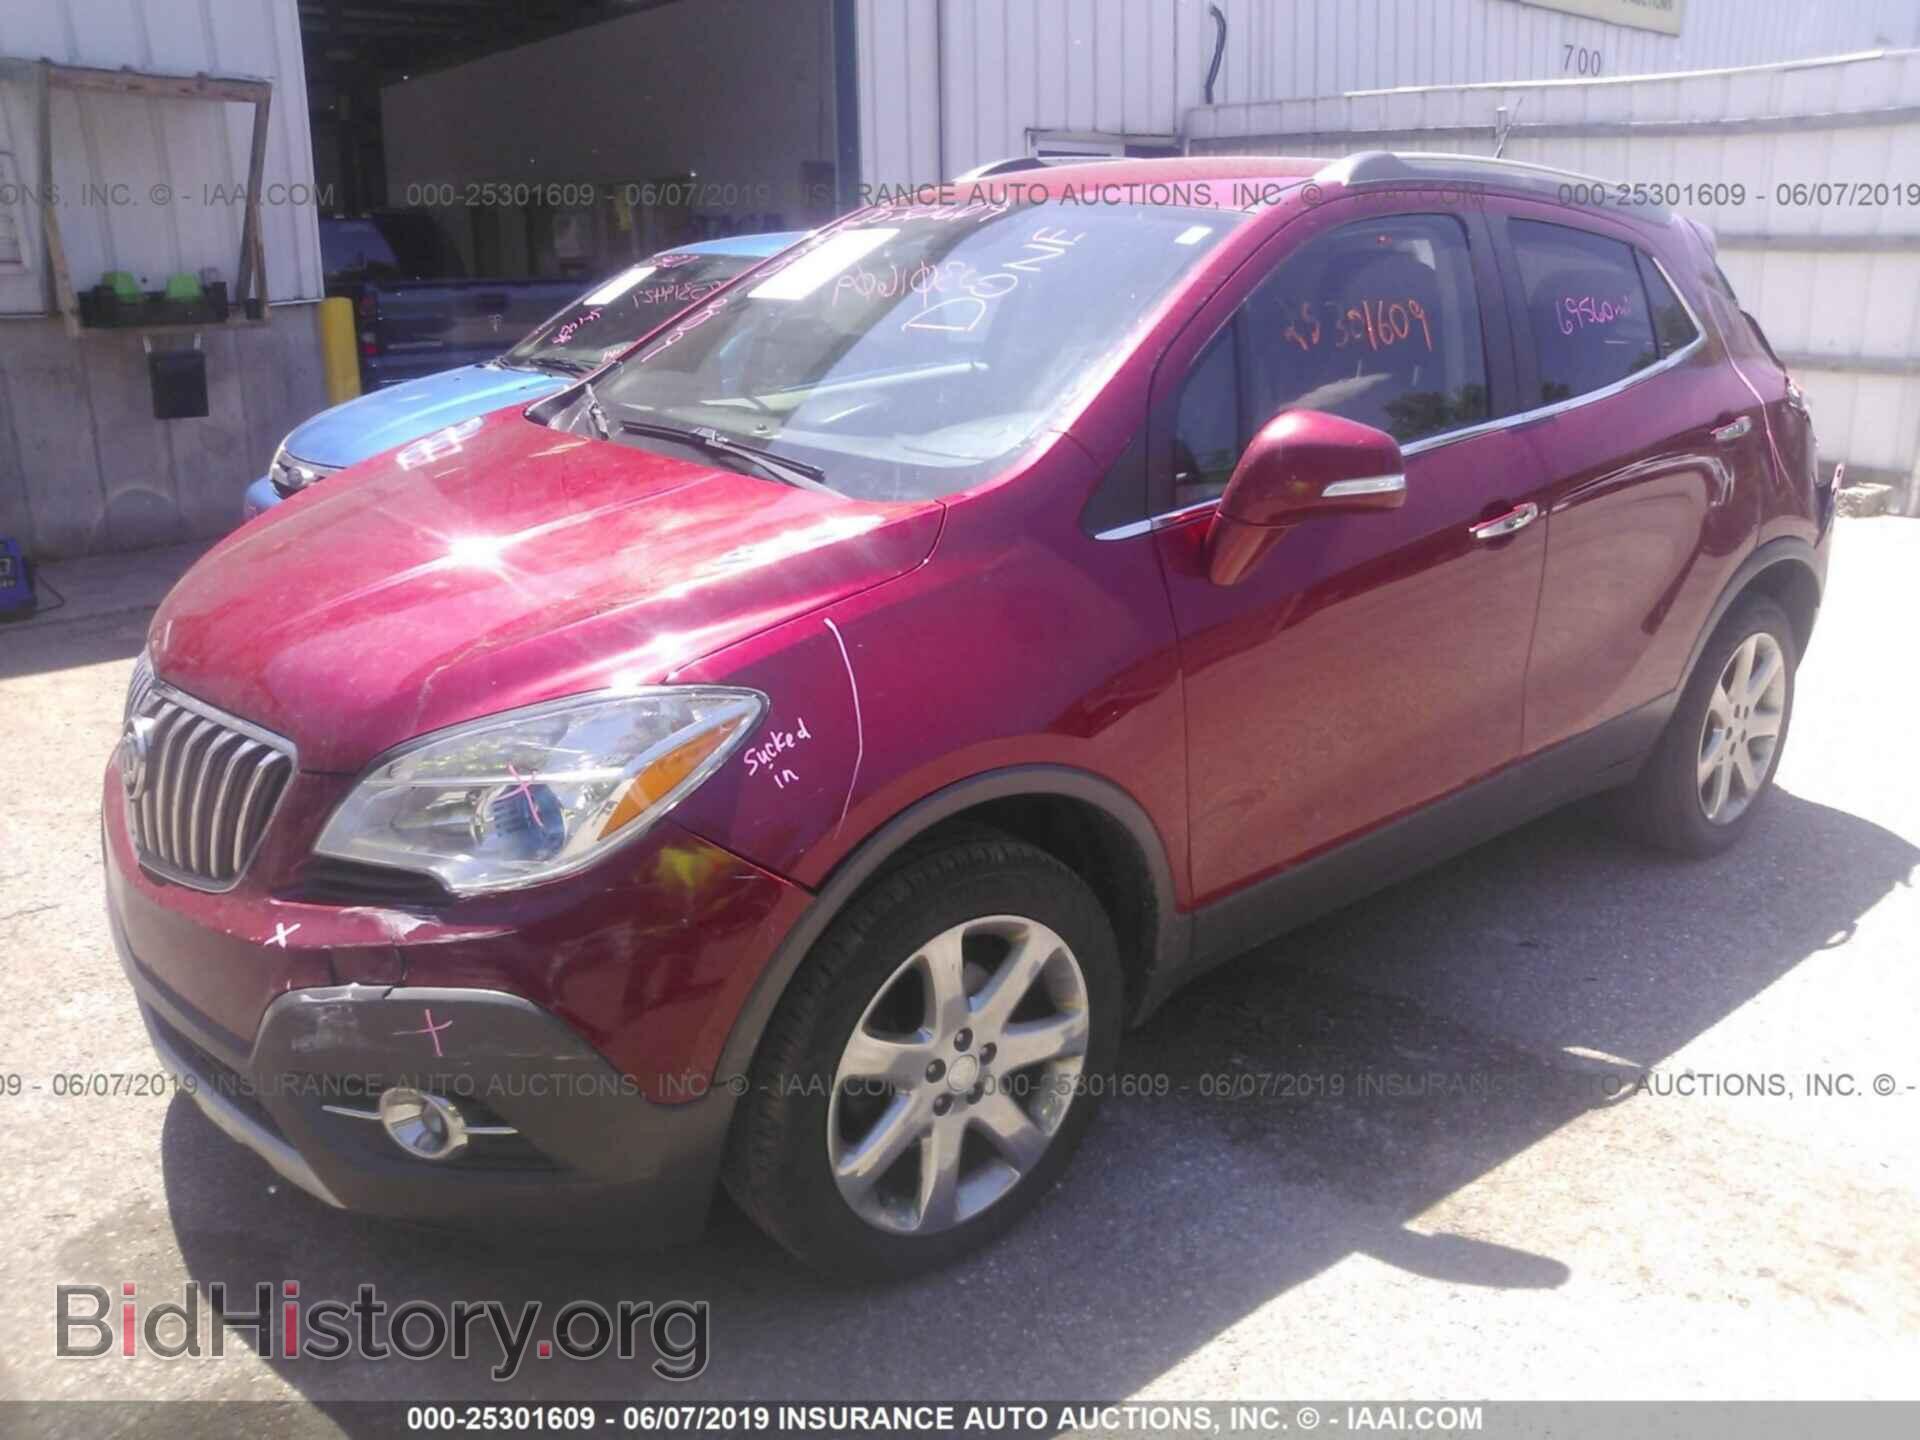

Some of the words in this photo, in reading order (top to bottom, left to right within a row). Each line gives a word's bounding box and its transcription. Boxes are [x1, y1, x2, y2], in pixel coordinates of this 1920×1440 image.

[1563, 45, 1601, 77] 700
[901, 226, 1087, 331] DONE
[744, 717, 812, 776] Sucked
[769, 763, 800, 789] in
